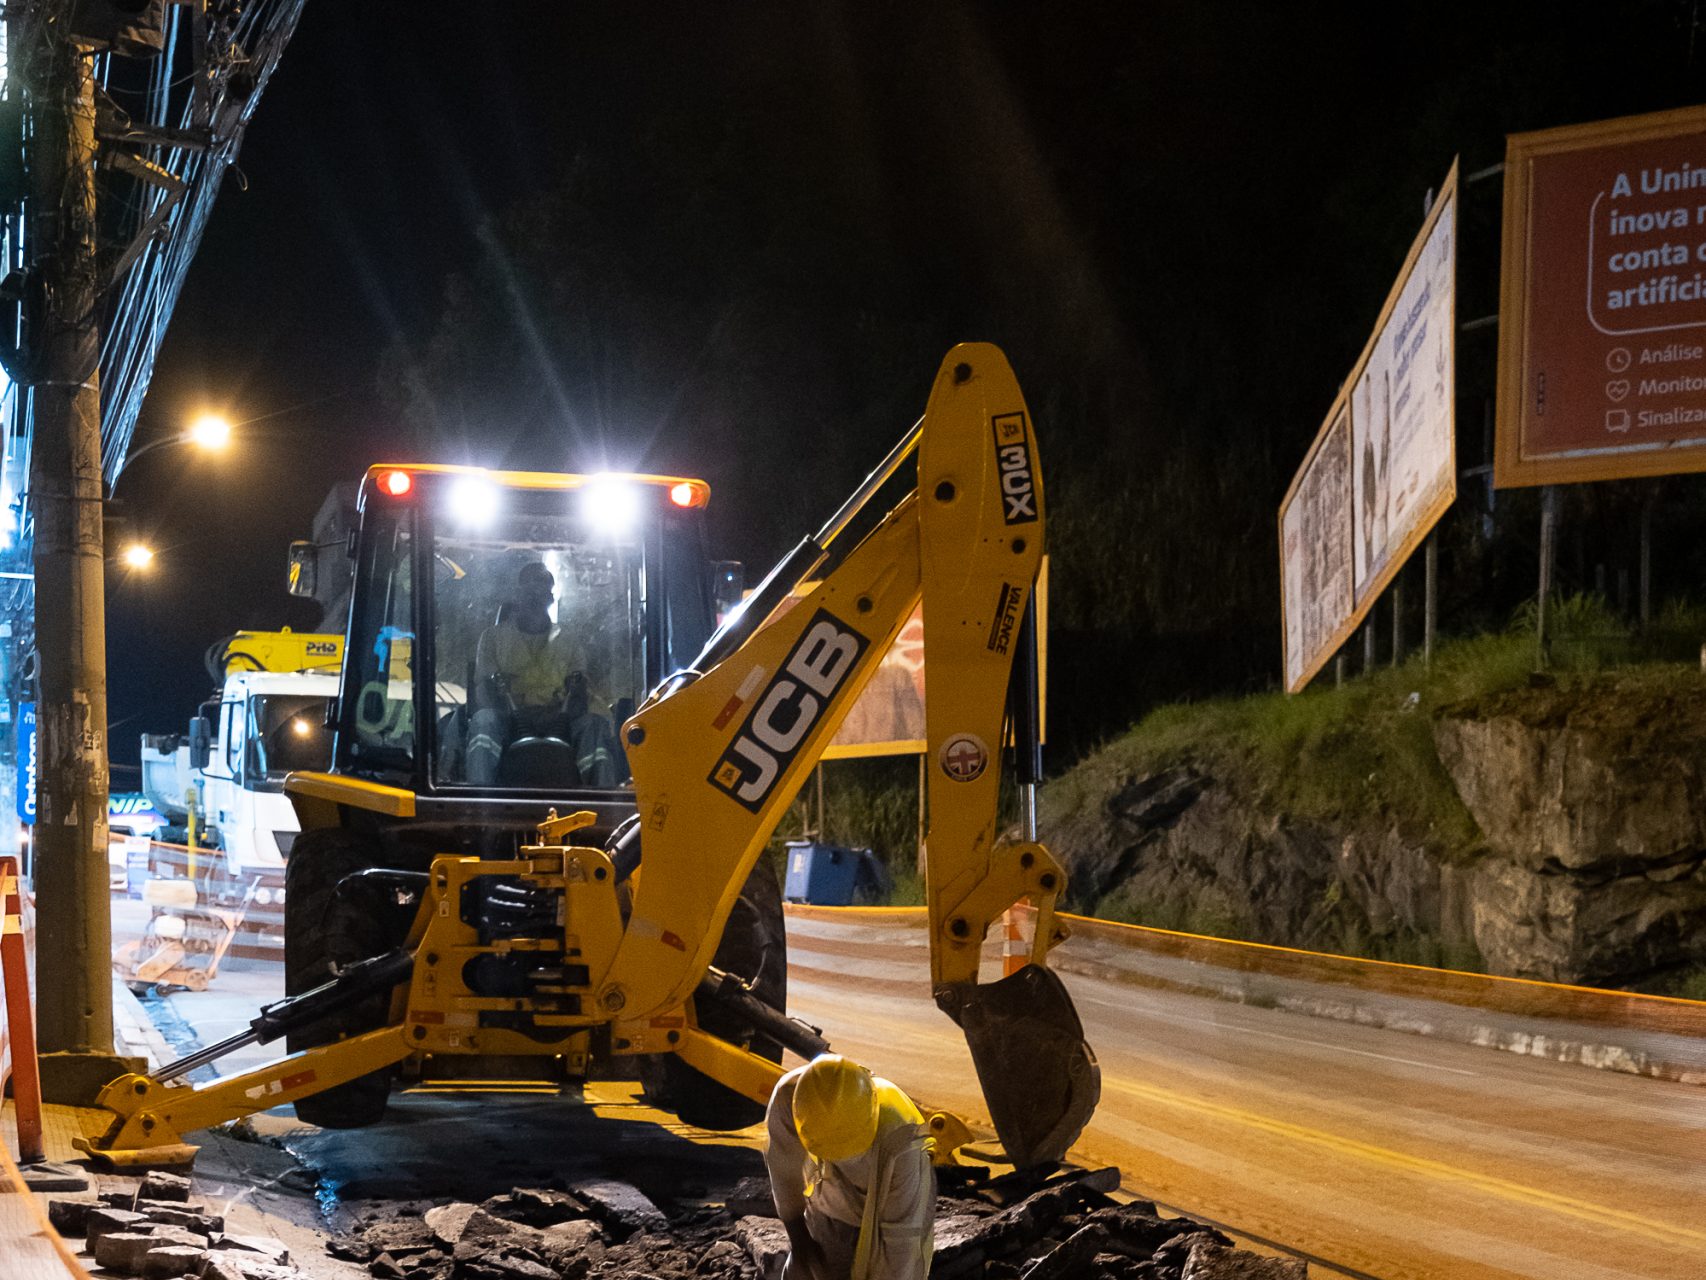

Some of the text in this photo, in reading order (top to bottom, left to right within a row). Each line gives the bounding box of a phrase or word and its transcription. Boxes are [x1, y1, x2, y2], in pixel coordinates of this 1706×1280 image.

[1611, 173, 1633, 200] A
[1609, 207, 1689, 236] inova
[1608, 242, 1689, 273] conta
[1607, 273, 1706, 310] artifici
[1640, 344, 1703, 364] Análise
[1000, 445, 1036, 520] 3CX
[996, 586, 1022, 656] VALENCE
[734, 621, 859, 802] JCB
